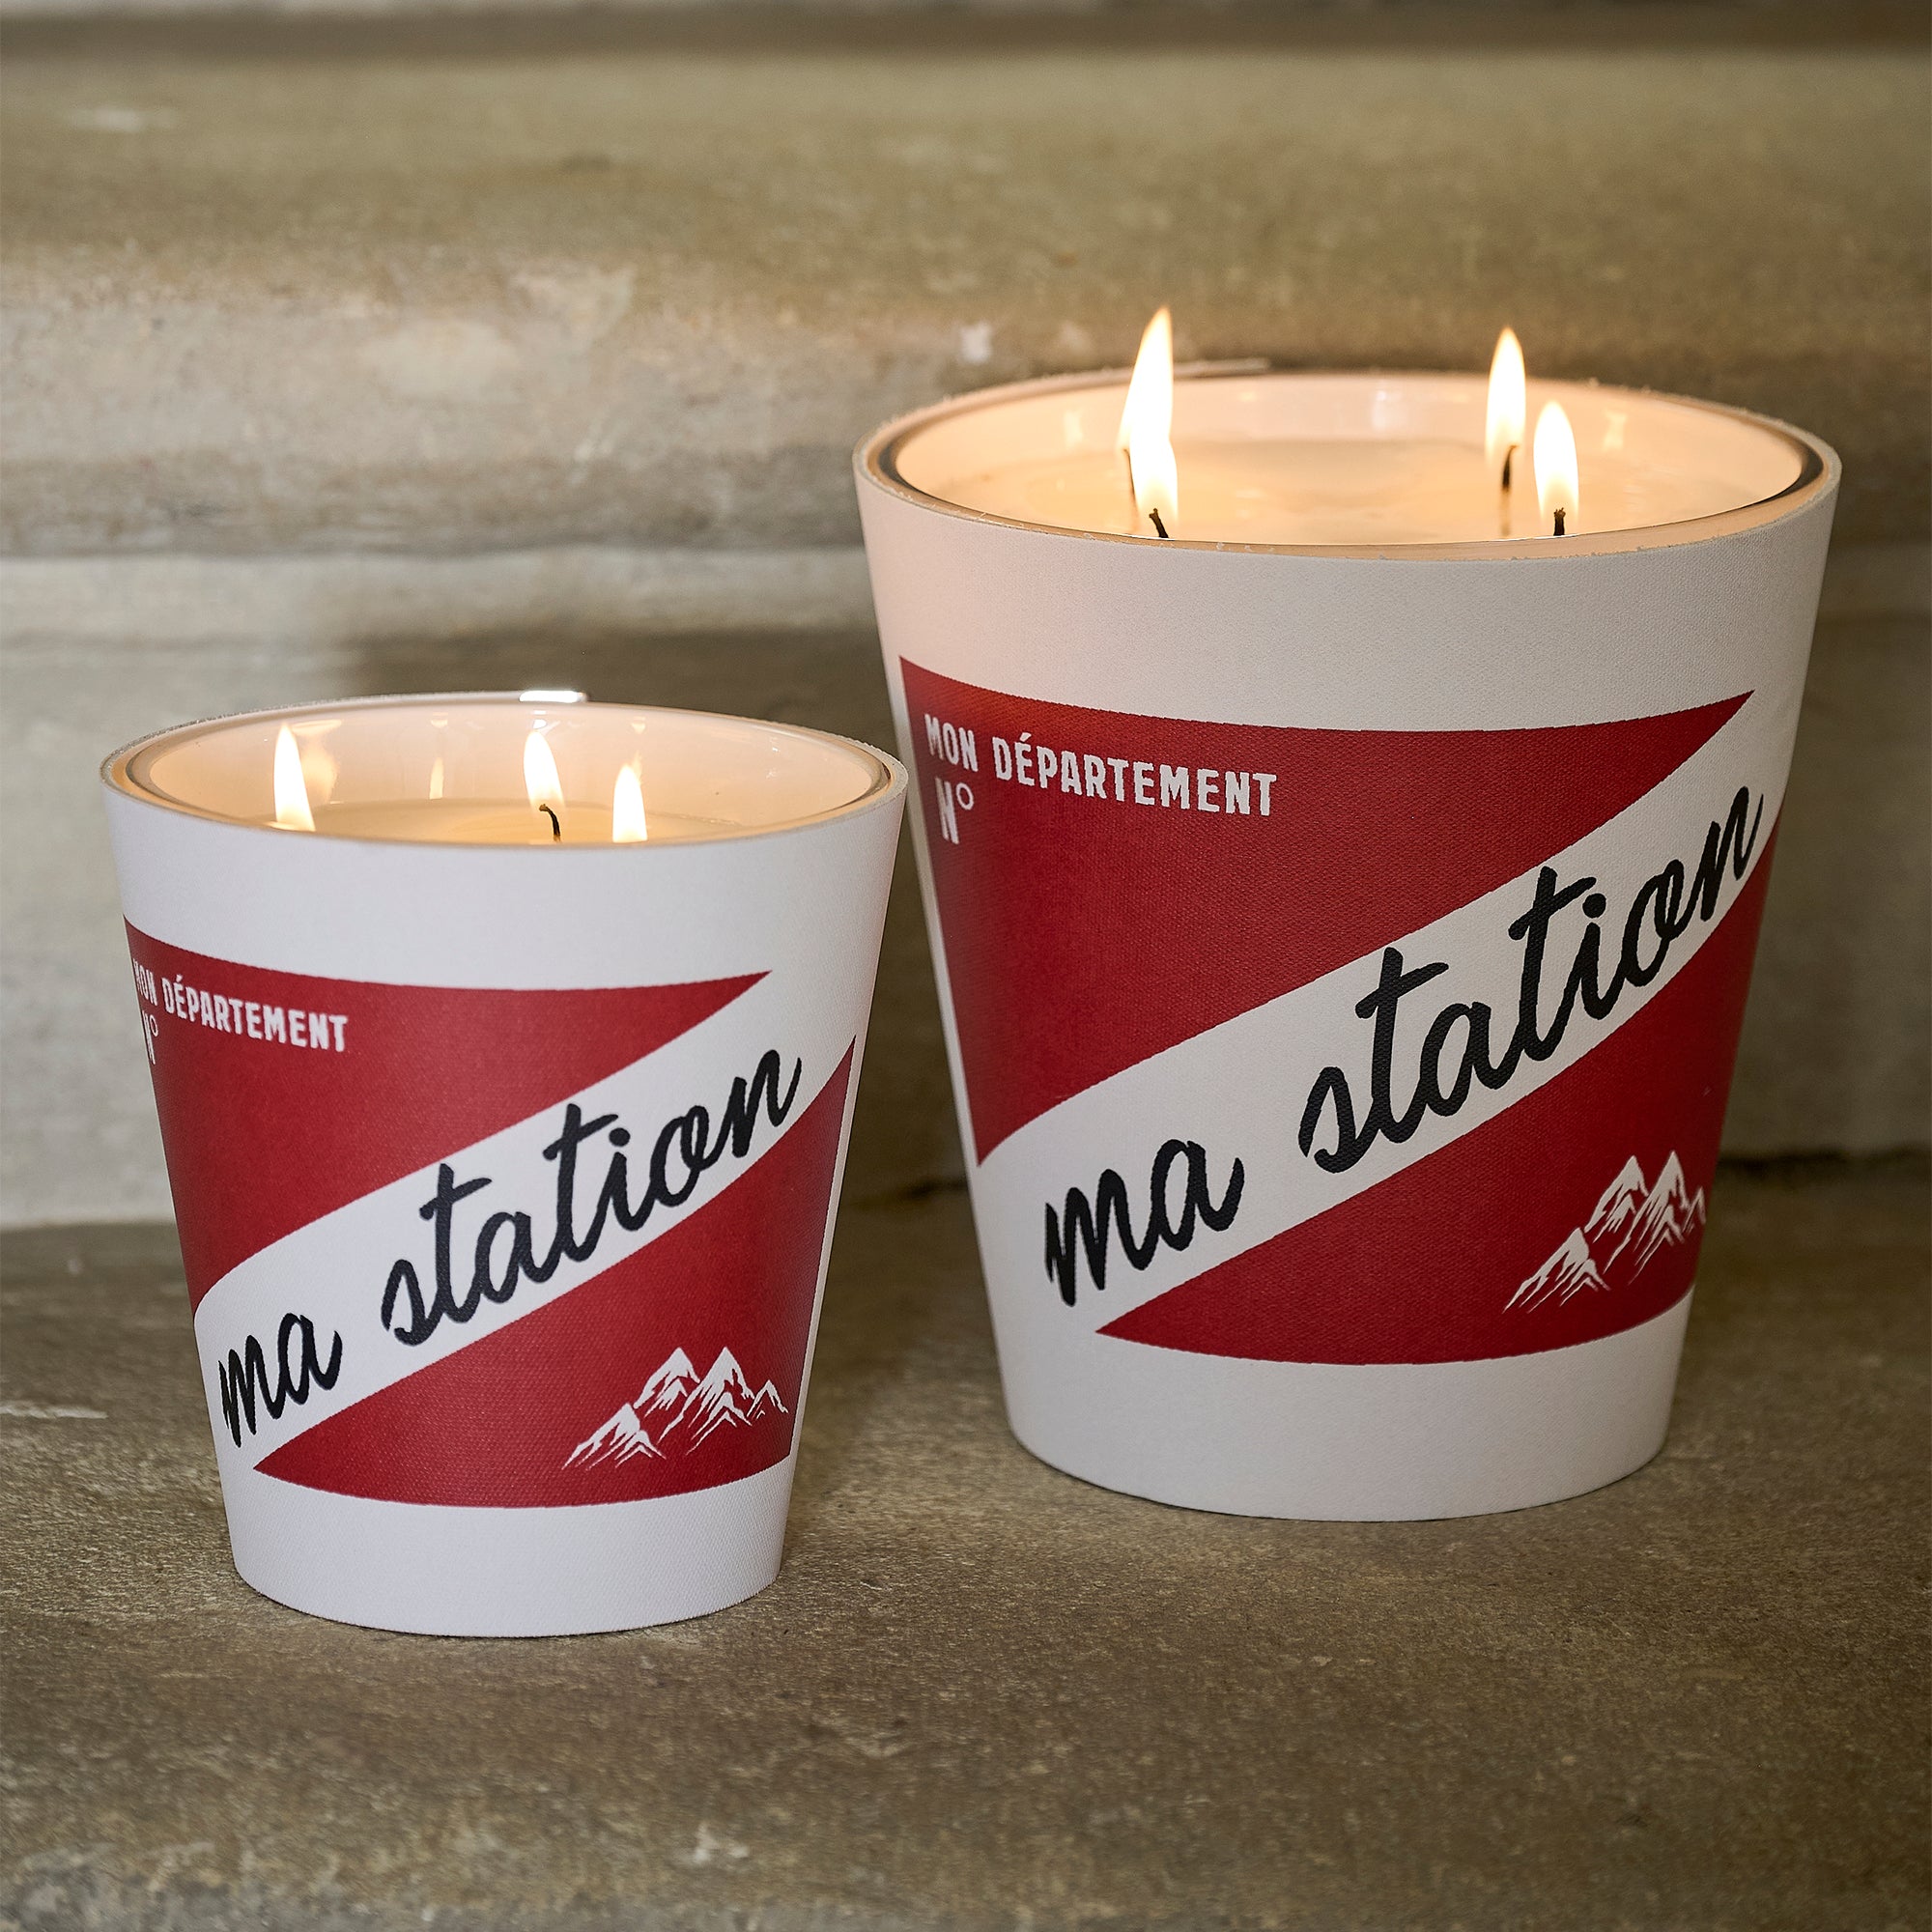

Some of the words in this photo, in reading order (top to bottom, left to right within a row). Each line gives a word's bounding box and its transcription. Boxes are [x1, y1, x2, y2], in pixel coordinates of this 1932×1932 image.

[923, 713, 979, 773] MON
[992, 732, 1277, 816] DÉPARTEMENT
[161, 974, 348, 1053] DÉPARTEMENT
[1044, 1139, 1245, 1307] ma
[1298, 784, 1765, 1174] station
[218, 1312, 342, 1447] ma
[381, 1049, 803, 1347] station
